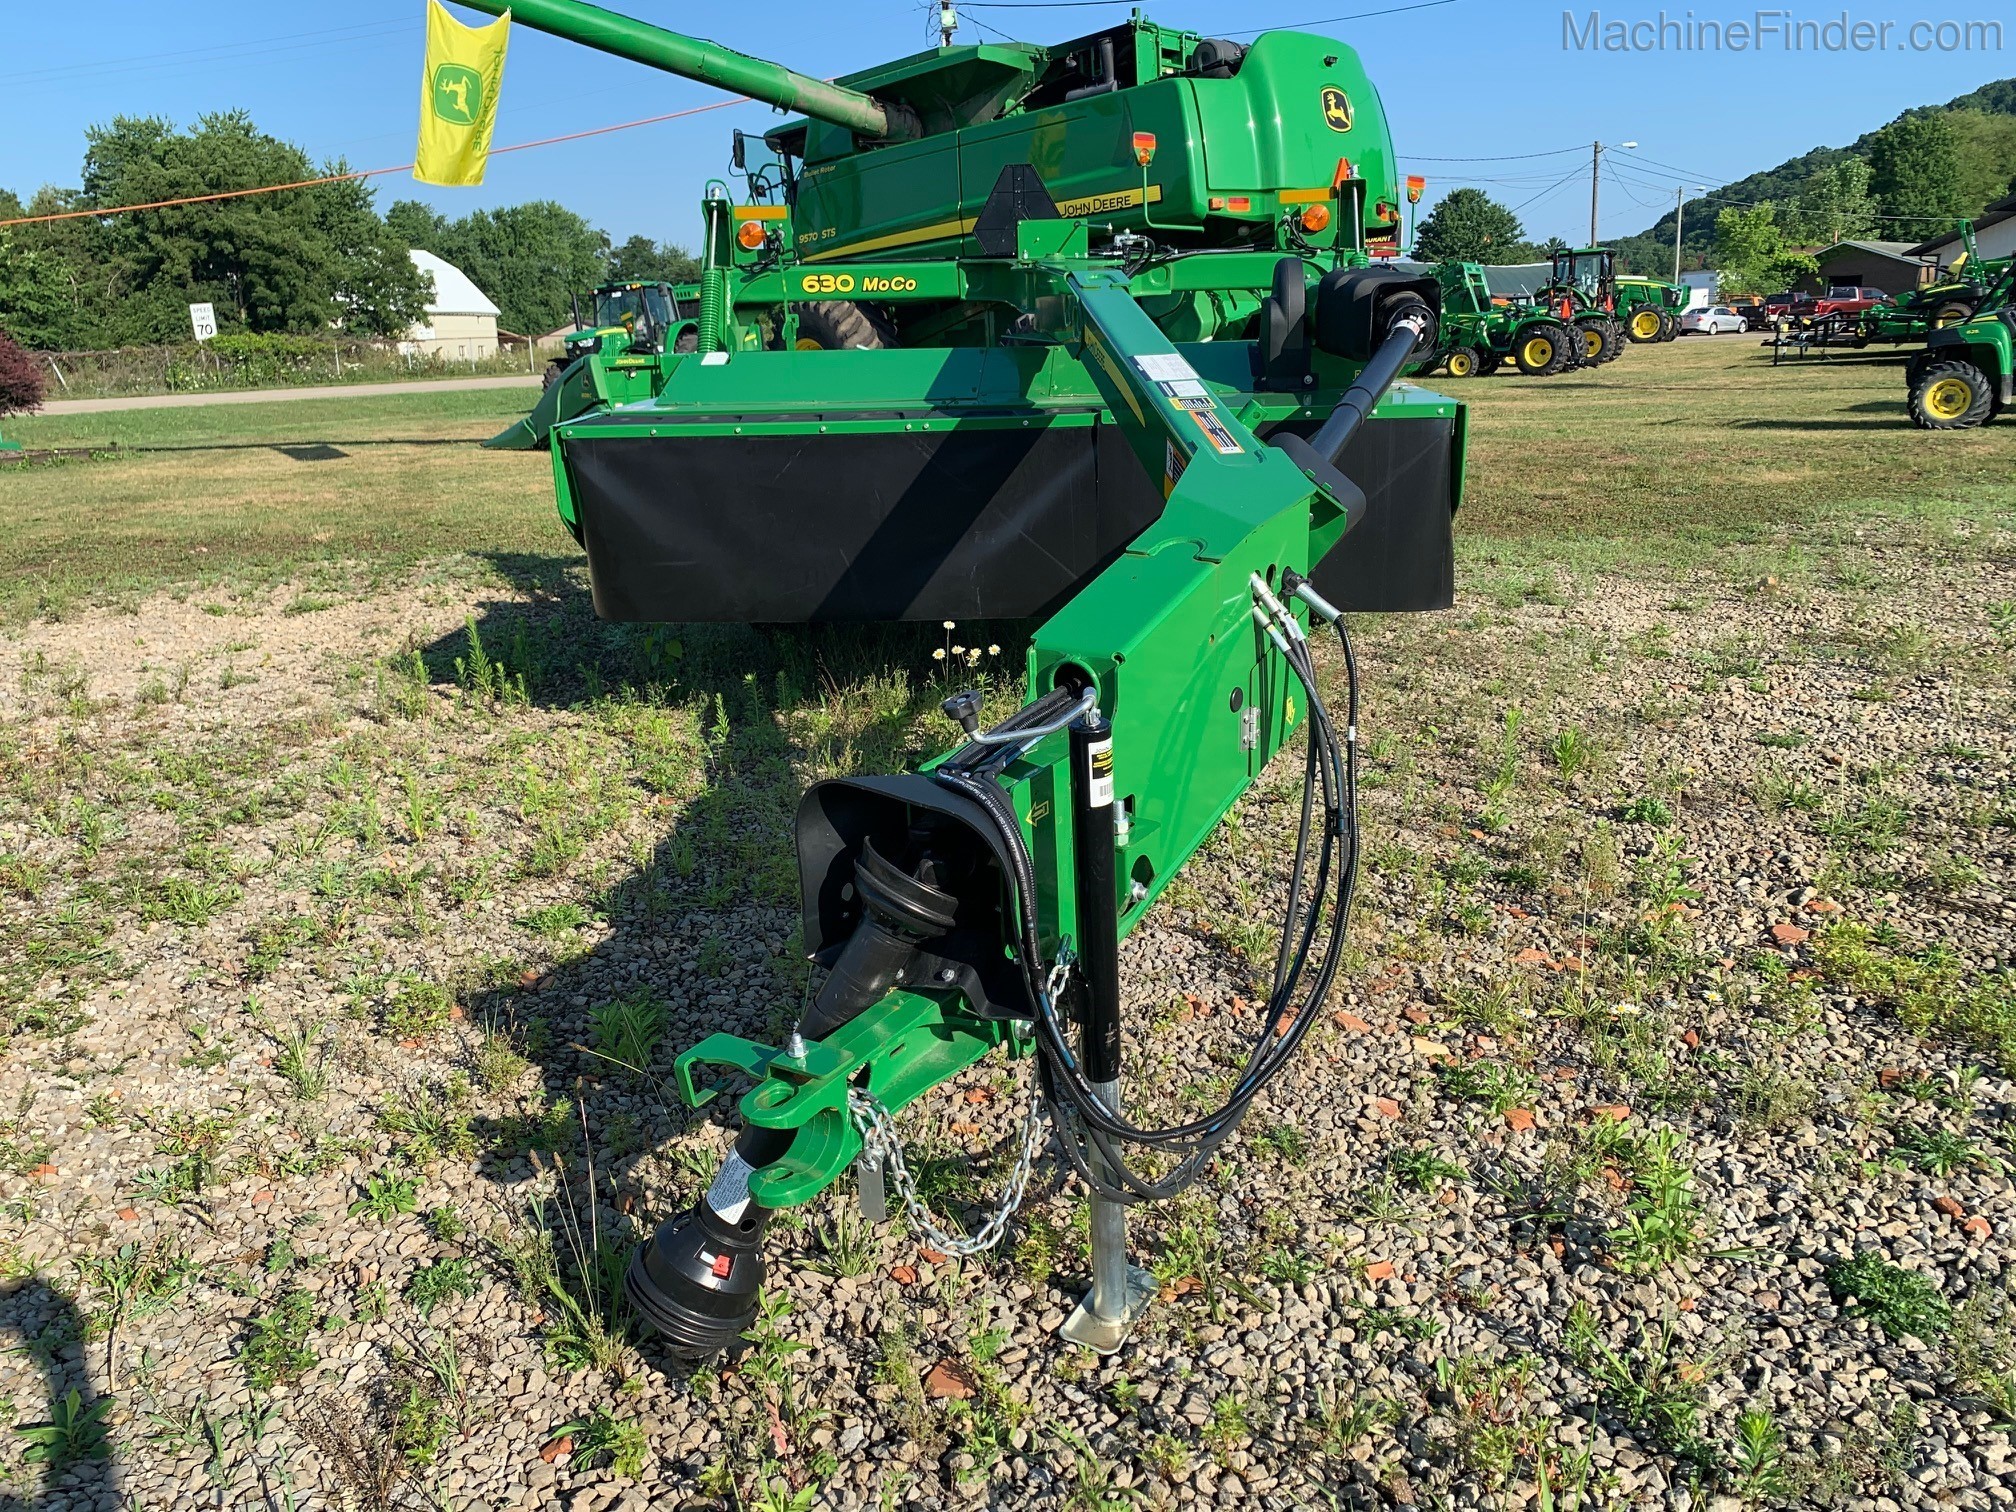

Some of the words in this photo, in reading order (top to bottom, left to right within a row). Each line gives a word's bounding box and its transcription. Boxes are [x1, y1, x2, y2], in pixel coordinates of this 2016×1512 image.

[1061, 201, 1091, 217] JOHN
[1093, 195, 1131, 211] DEERE
[799, 232, 818, 244] 9570
[821, 227, 836, 239] STS
[802, 273, 855, 294] 630
[861, 276, 917, 292] MoCo
[197, 324, 213, 335] 70
